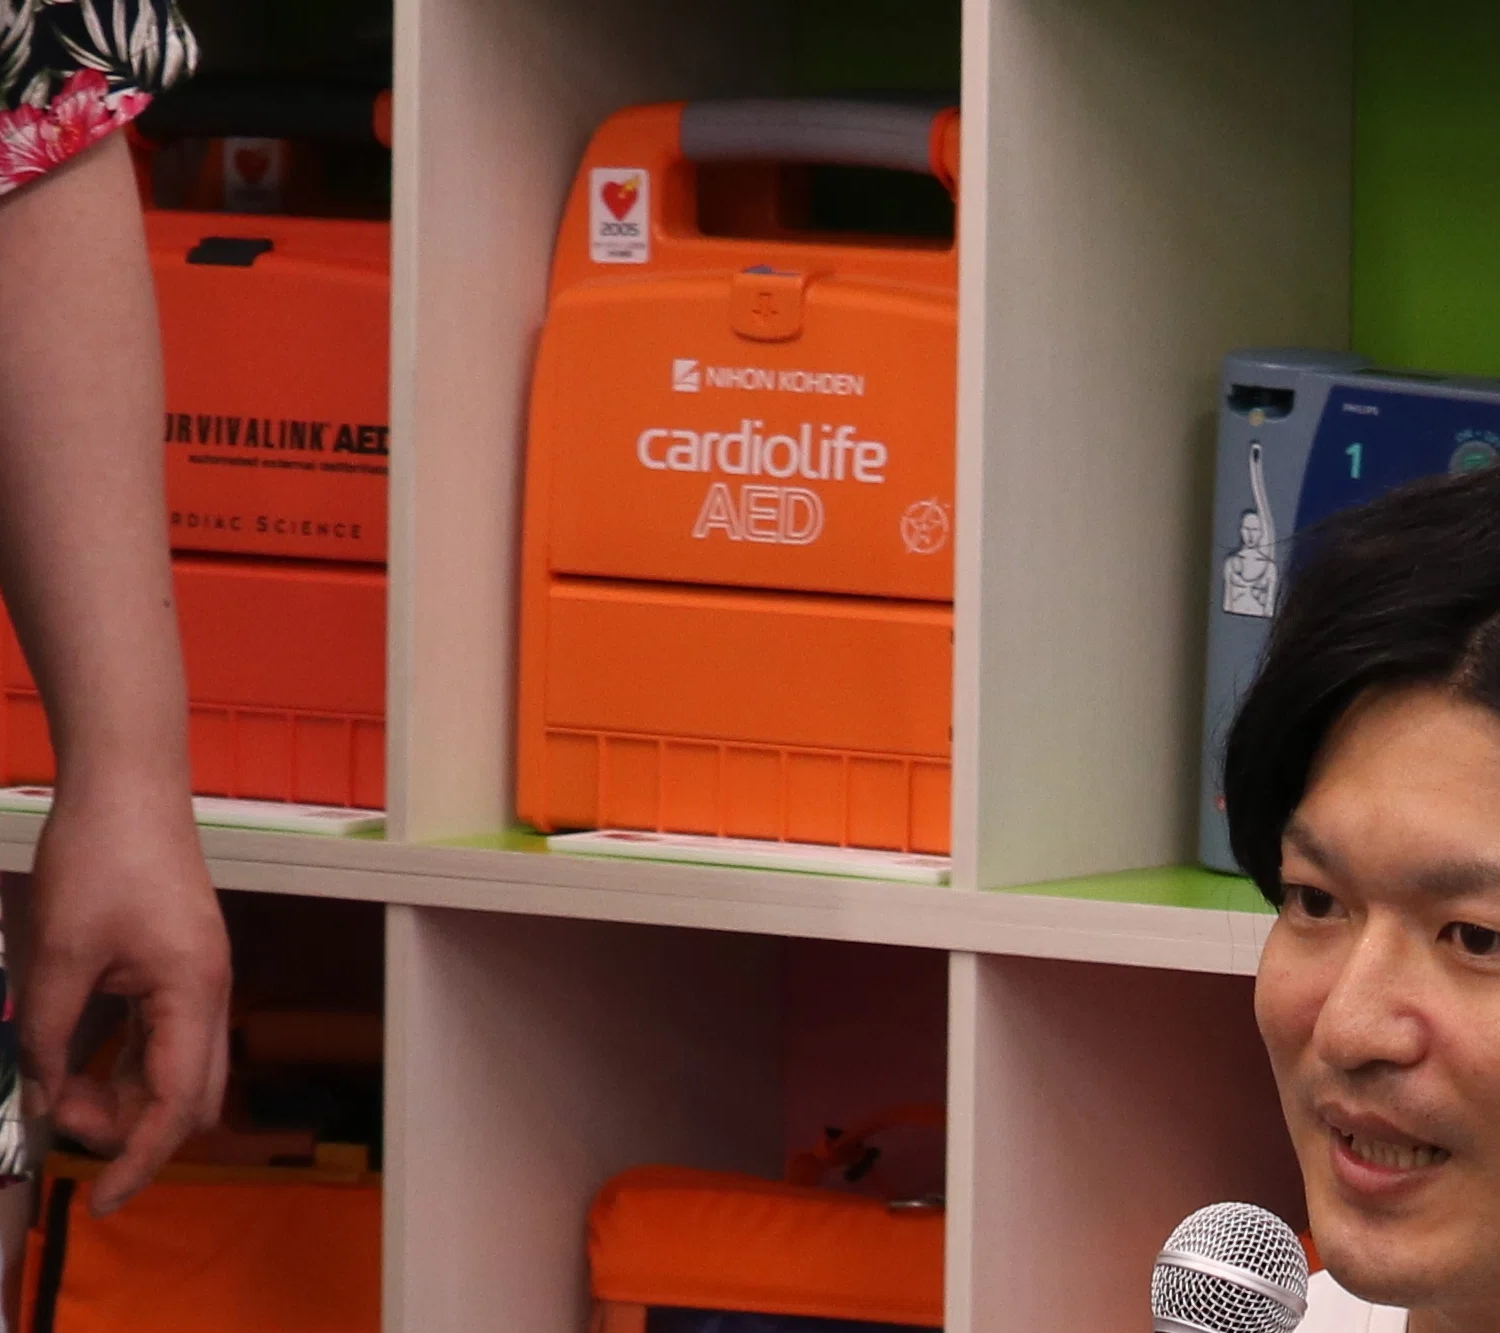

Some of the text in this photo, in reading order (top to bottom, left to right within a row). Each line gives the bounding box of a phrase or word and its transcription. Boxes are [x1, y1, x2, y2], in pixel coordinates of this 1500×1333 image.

[706, 366, 865, 396] NIHON KOHDEN
[636, 418, 888, 484] cardiolife
[1345, 442, 1363, 479] 1
[691, 482, 825, 545] AED
